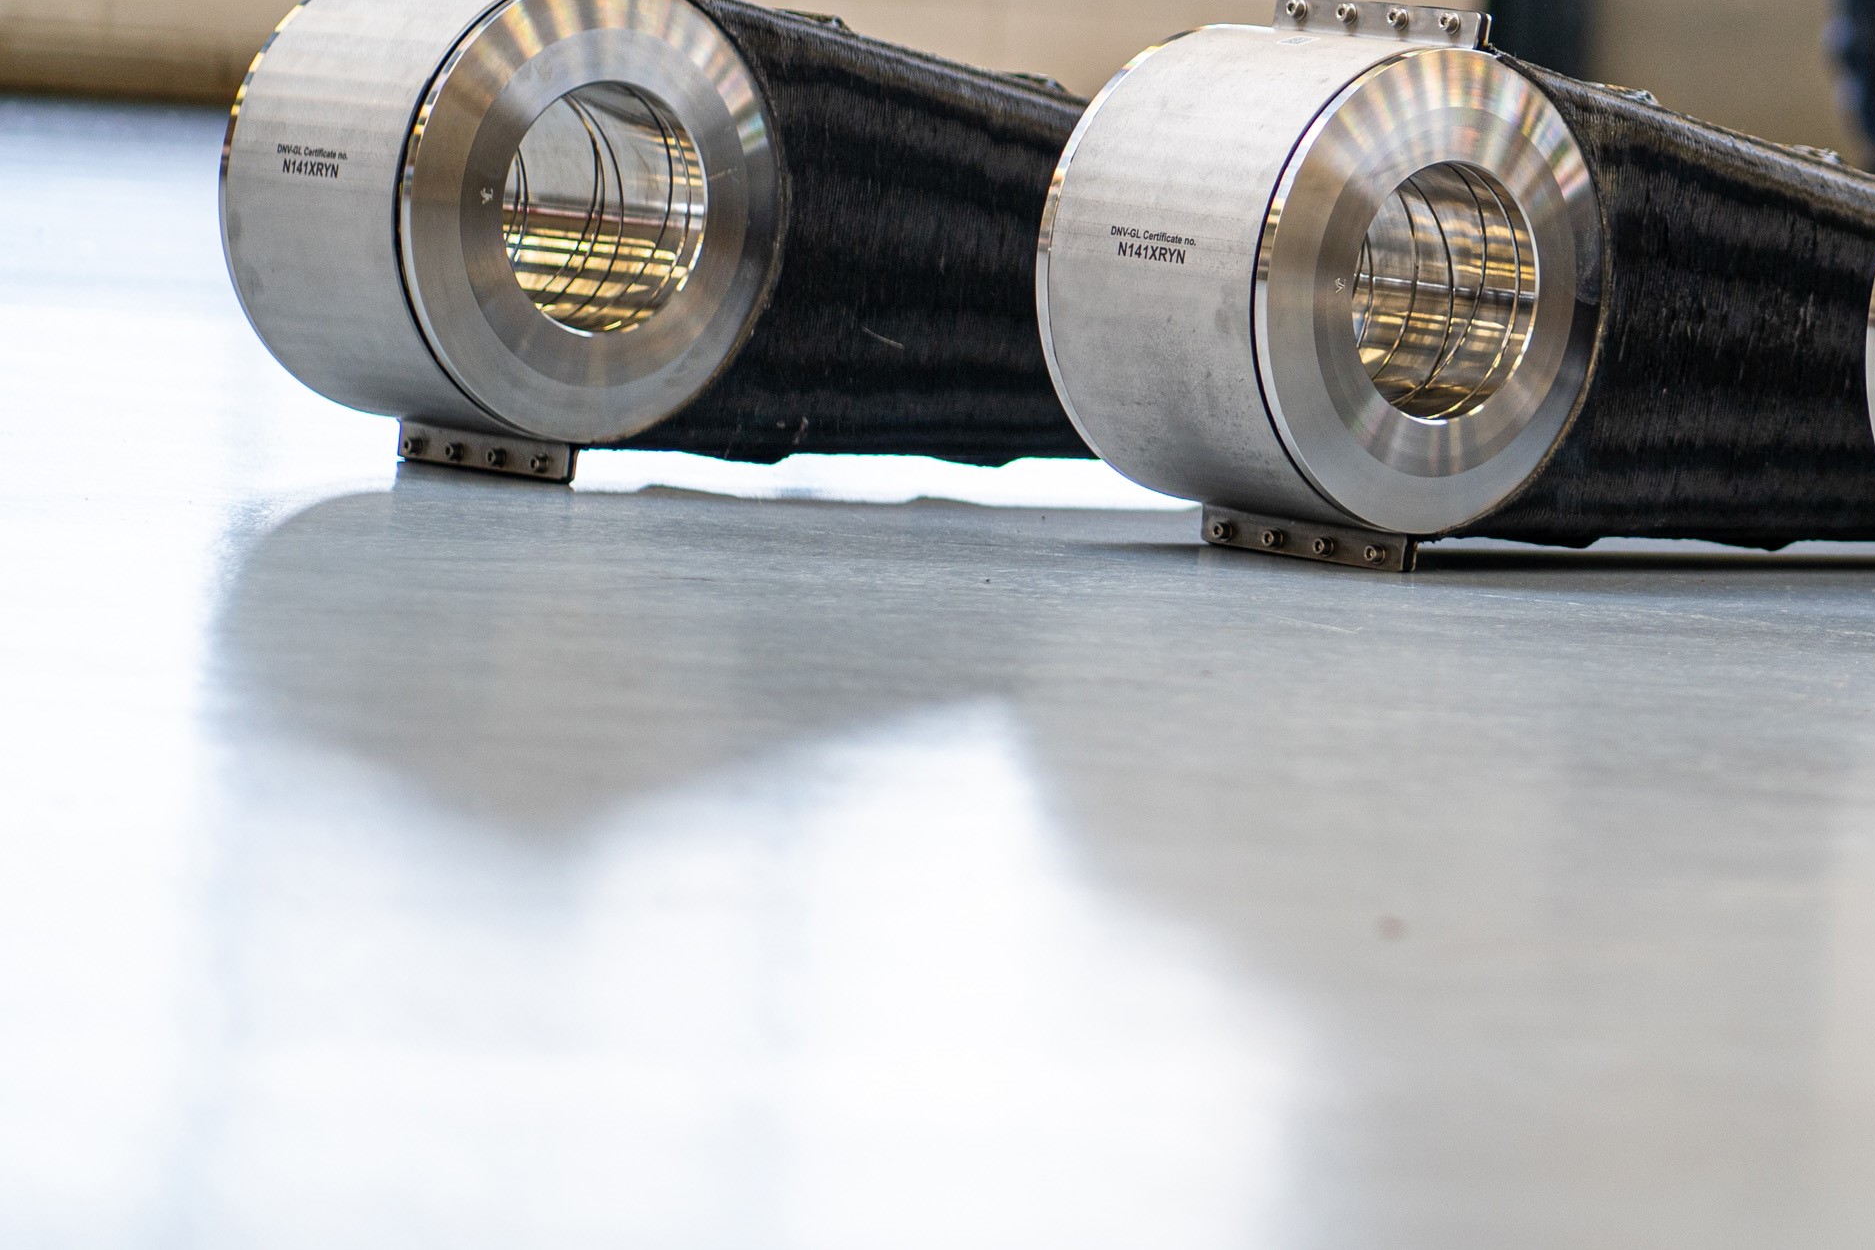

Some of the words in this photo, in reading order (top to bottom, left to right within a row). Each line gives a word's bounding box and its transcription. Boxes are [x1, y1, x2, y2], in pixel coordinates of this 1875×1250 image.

[303, 147, 337, 159] Certificate
[282, 158, 339, 179] N141XRYN
[1110, 226, 1141, 239] DNV-GL
[1143, 230, 1182, 245] Certificate
[1184, 237, 1197, 247] no.
[1118, 241, 1186, 265] N141XRYN
